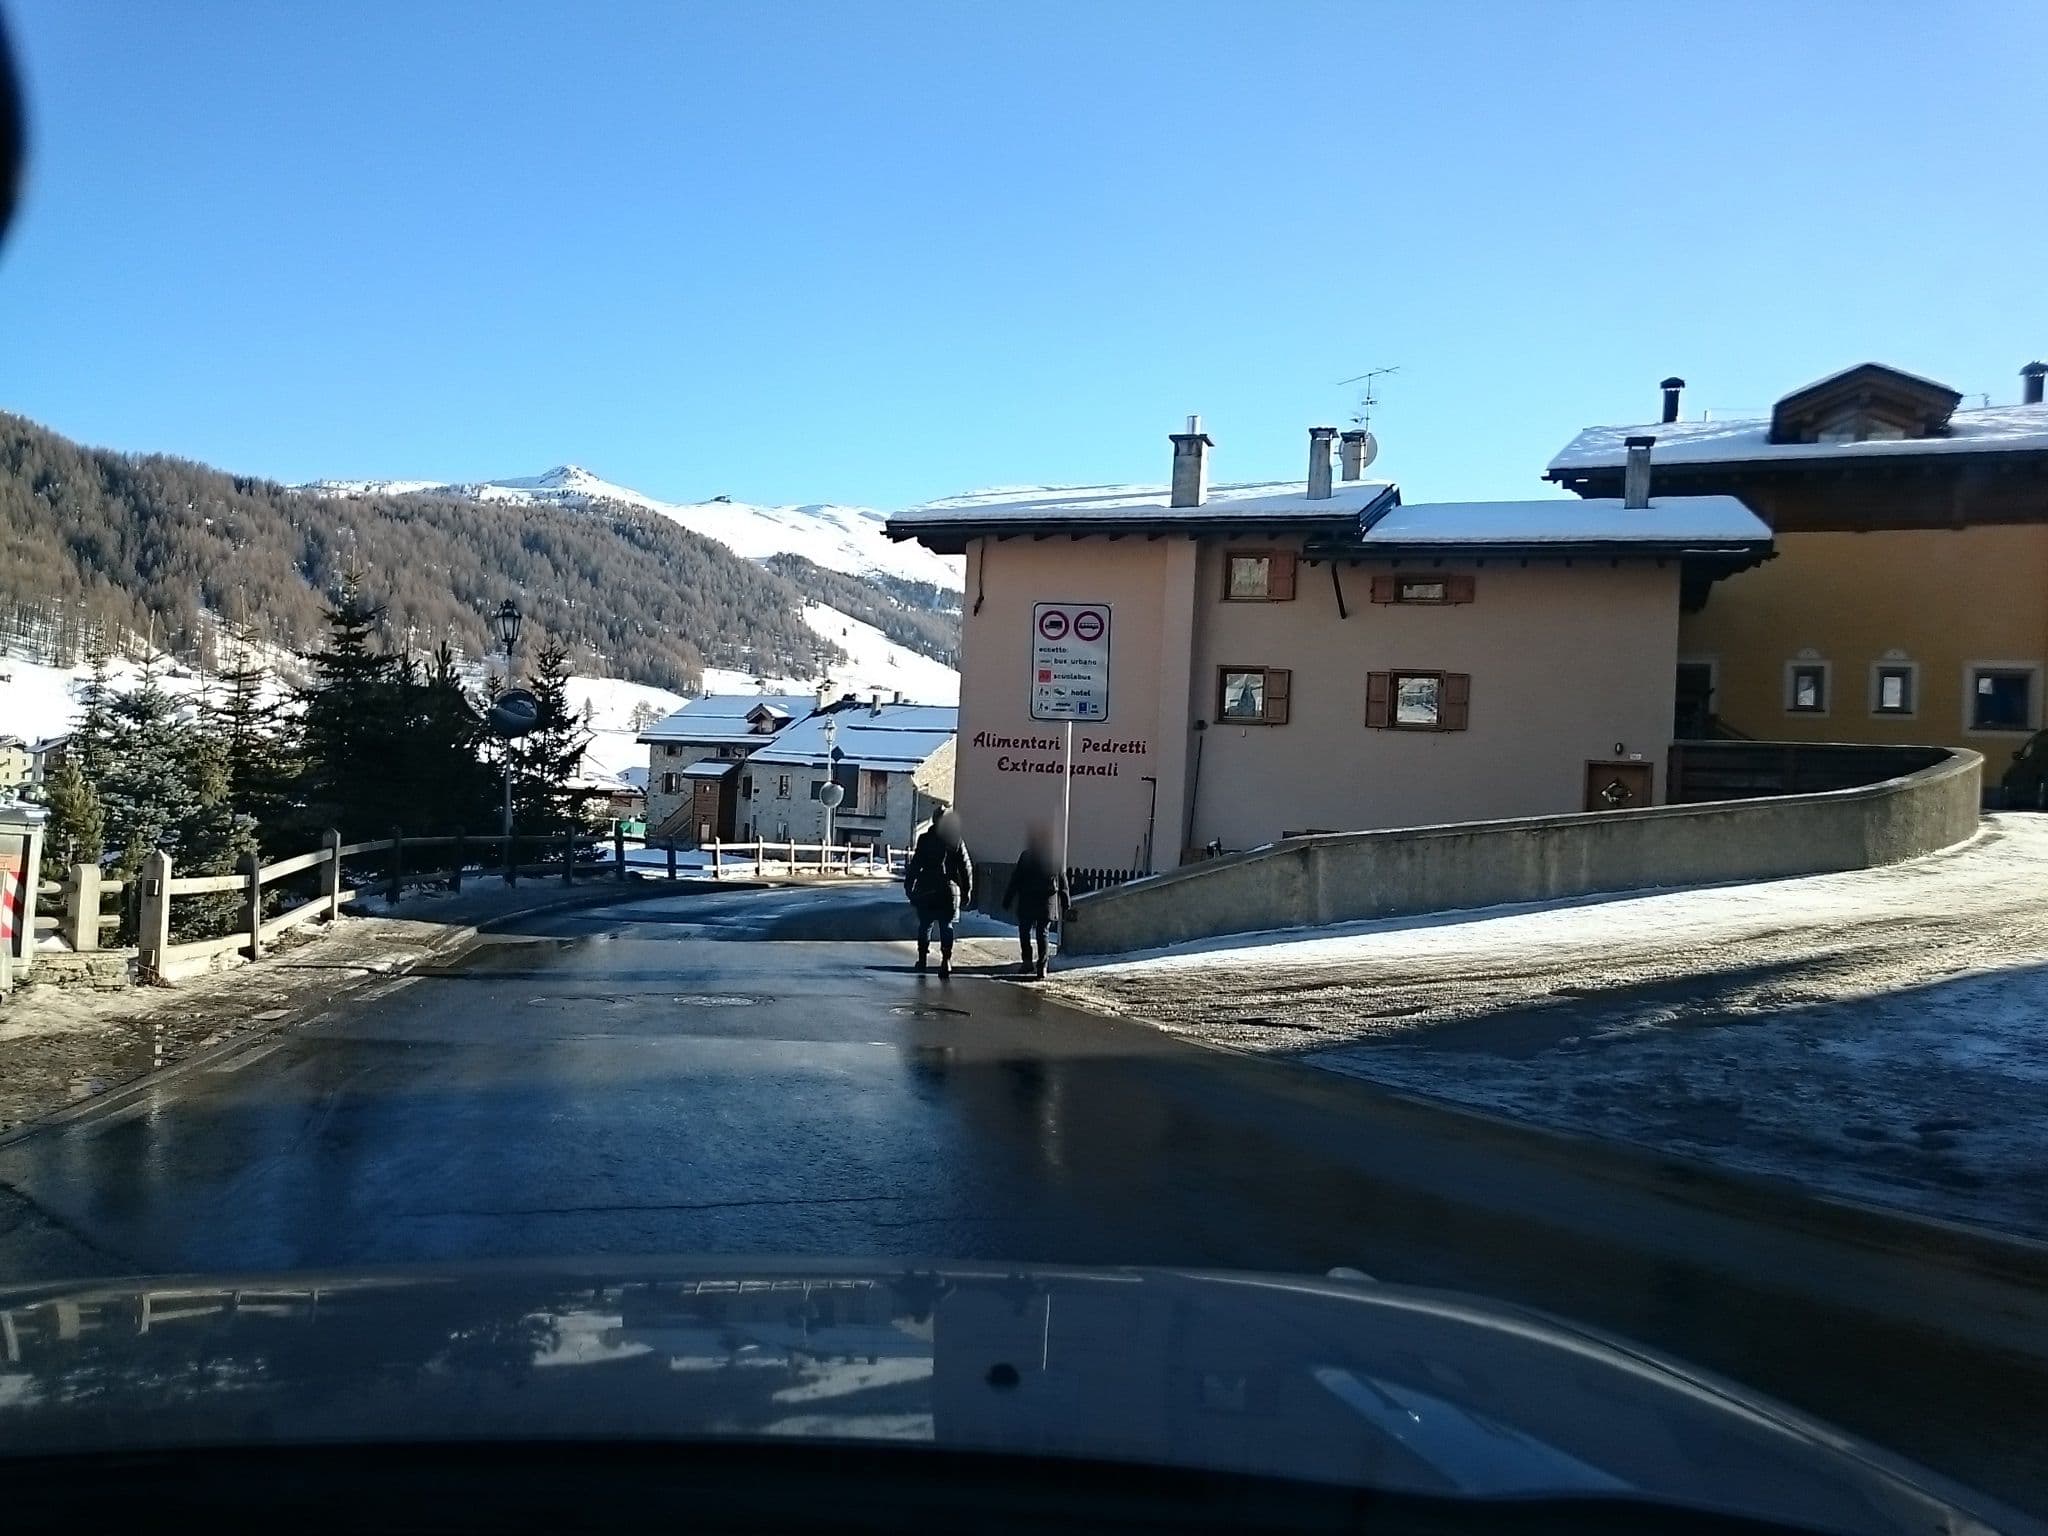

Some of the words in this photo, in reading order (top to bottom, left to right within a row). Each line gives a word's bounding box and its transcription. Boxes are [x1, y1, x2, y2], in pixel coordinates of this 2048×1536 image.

[1071, 658, 1097, 666] urbano
[1054, 672, 1092, 681] scuolabus
[1071, 689, 1091, 697] hotel
[973, 731, 1061, 750] Alimentari
[1082, 738, 1147, 754] Pedretti
